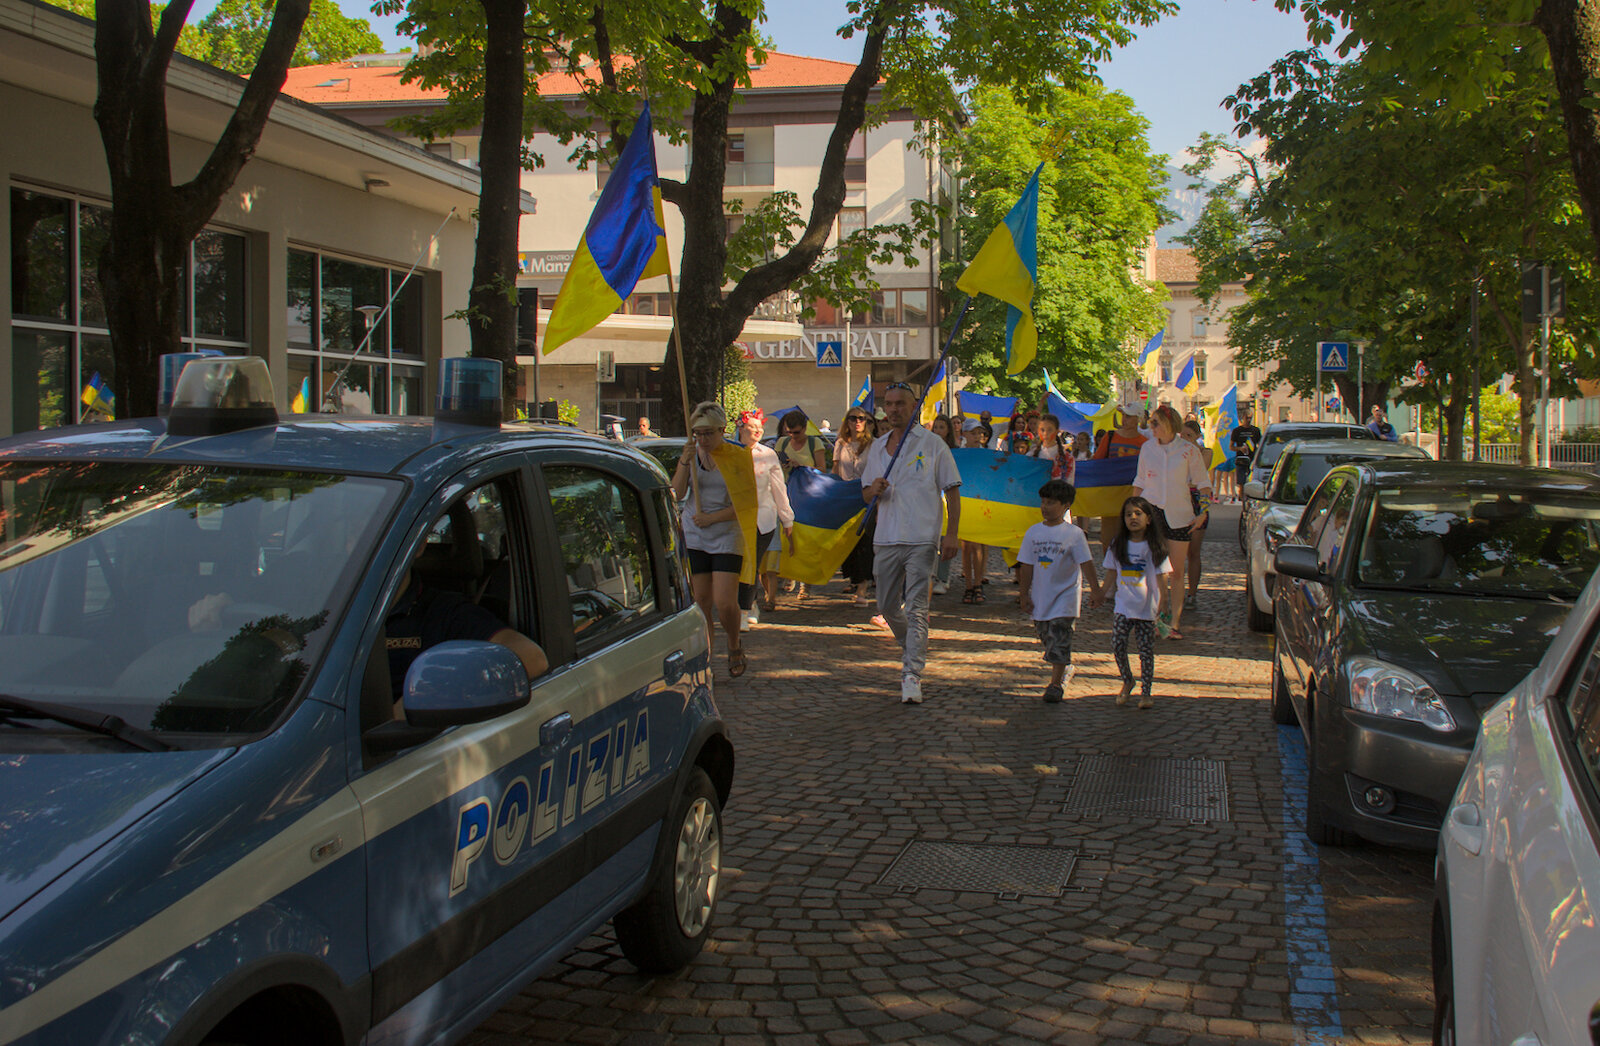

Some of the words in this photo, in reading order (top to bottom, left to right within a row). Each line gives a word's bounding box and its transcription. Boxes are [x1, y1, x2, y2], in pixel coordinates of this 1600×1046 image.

[546, 254, 570, 262] CENTRO
[385, 639, 418, 648] POLIZIA
[449, 706, 650, 898] POLIZIA
